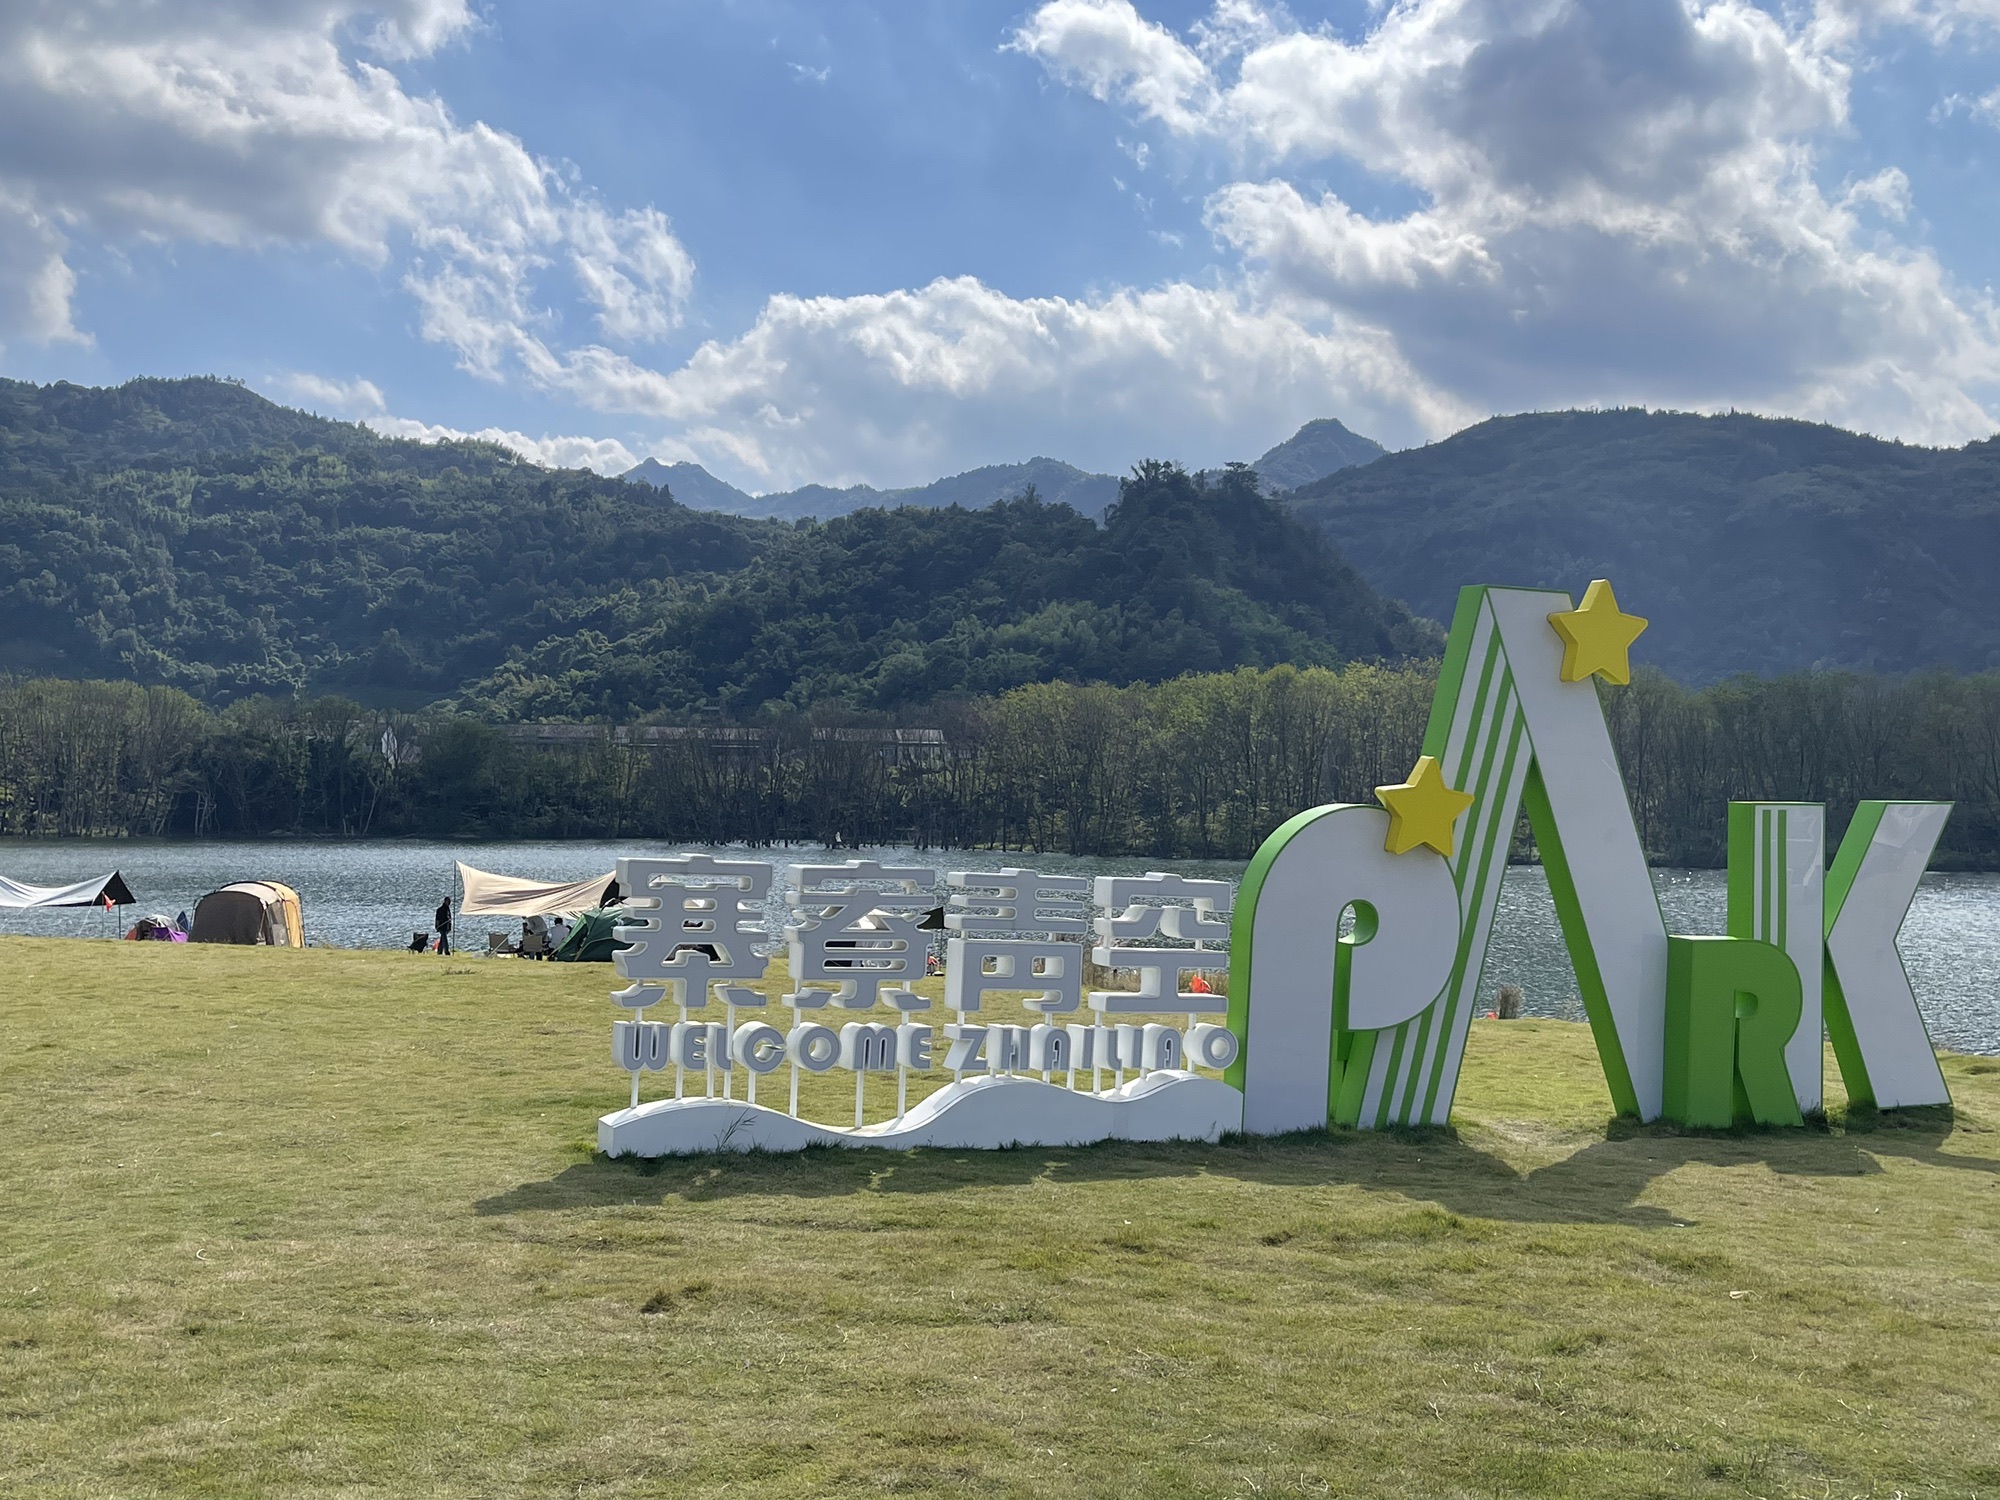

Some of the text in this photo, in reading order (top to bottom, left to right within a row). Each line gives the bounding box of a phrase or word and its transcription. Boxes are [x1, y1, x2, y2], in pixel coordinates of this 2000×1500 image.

[1230, 584, 1954, 1135] PARK
[612, 1020, 1239, 1074] WELCOME ZHAILIAO
